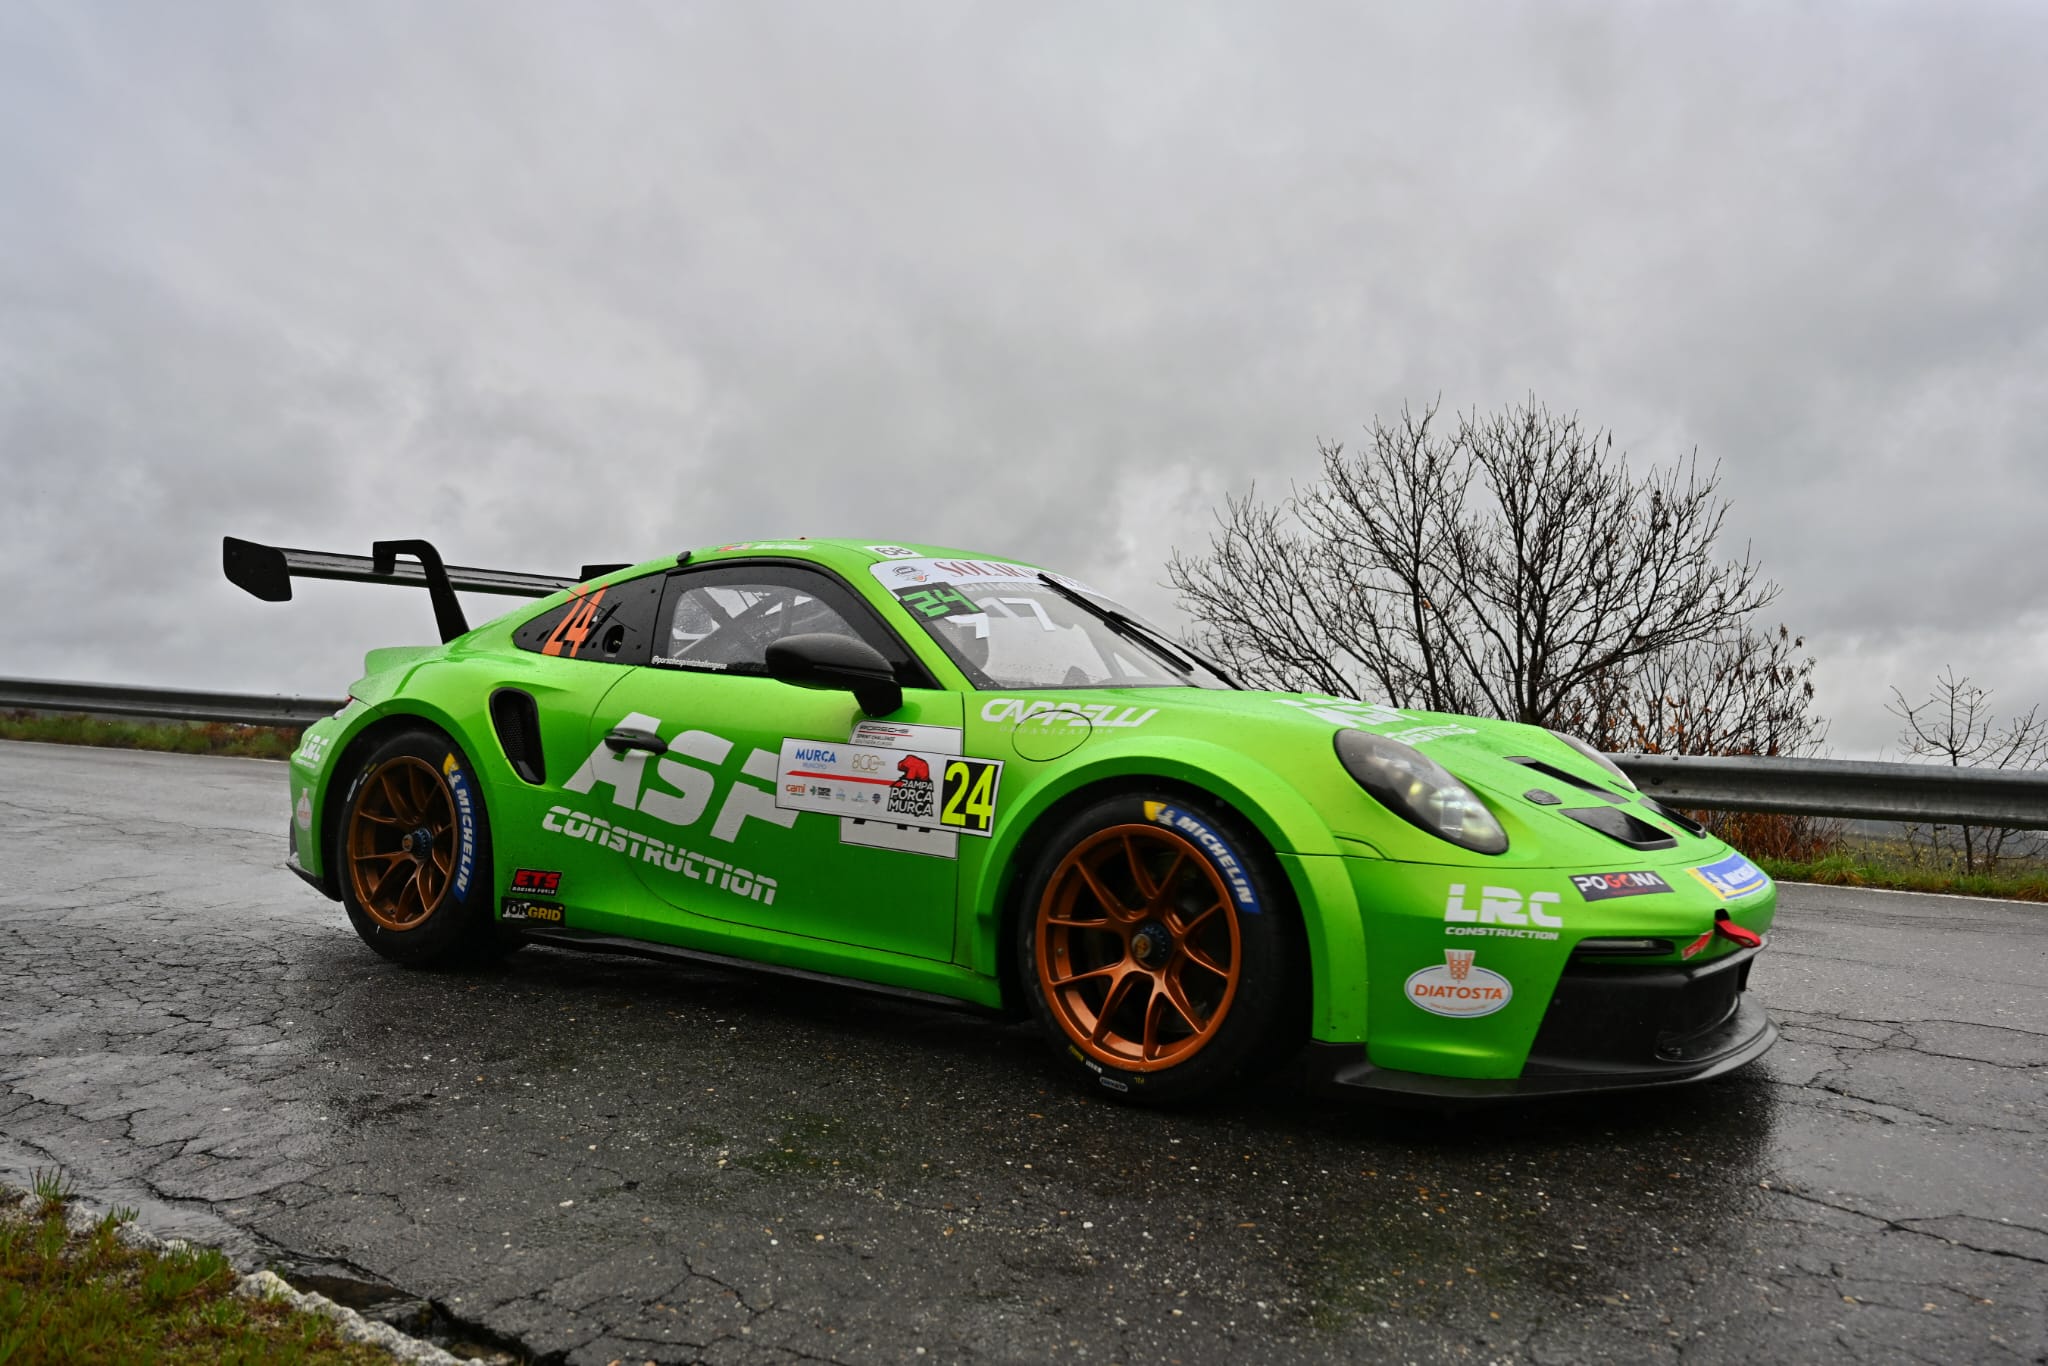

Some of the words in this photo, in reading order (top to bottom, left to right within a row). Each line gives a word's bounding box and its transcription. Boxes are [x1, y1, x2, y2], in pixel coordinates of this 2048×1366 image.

[542, 582, 609, 658] 24
[902, 588, 981, 618] 24
[859, 725, 910, 734] PORSCHE
[887, 799, 934, 818] MURÇA
[941, 761, 994, 830] 24
[456, 788, 473, 892] MICHELIN
[542, 805, 778, 906] CONSTRUCTION
[1176, 815, 1255, 904] MICHELIN
[515, 870, 561, 889] ETS
[1443, 883, 1563, 929] LRC
[1444, 926, 1560, 941] CONSTRUCTION
[1414, 983, 1504, 1000] DIATOSTA
